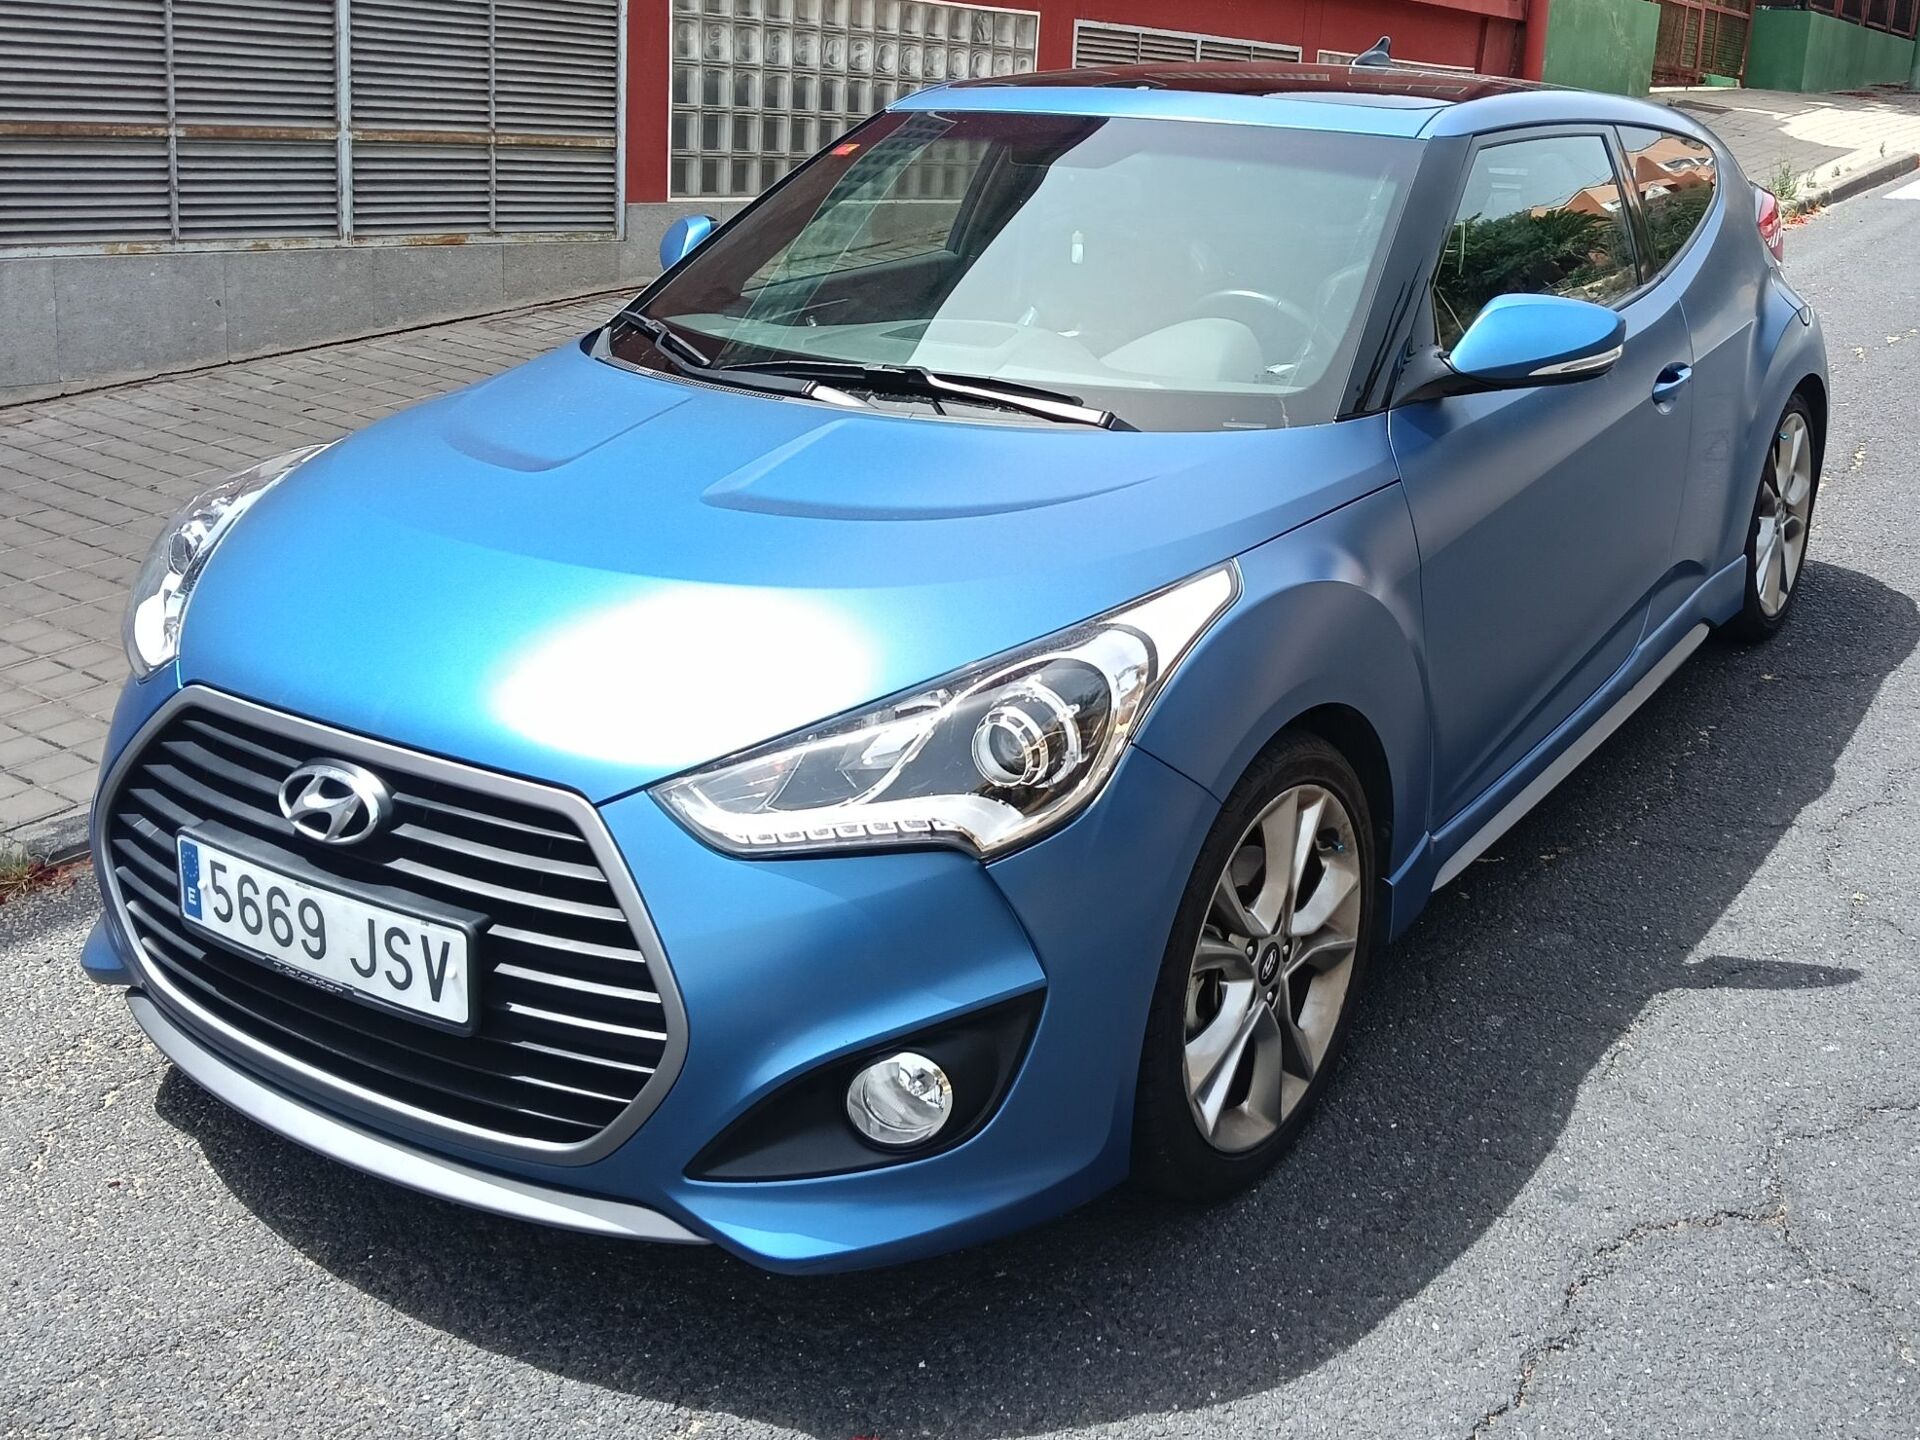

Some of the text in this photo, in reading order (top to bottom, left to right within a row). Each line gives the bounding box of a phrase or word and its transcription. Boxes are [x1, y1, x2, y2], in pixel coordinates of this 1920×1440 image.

[187, 886, 198, 906] E
[209, 859, 450, 1003] 5669 JSV
